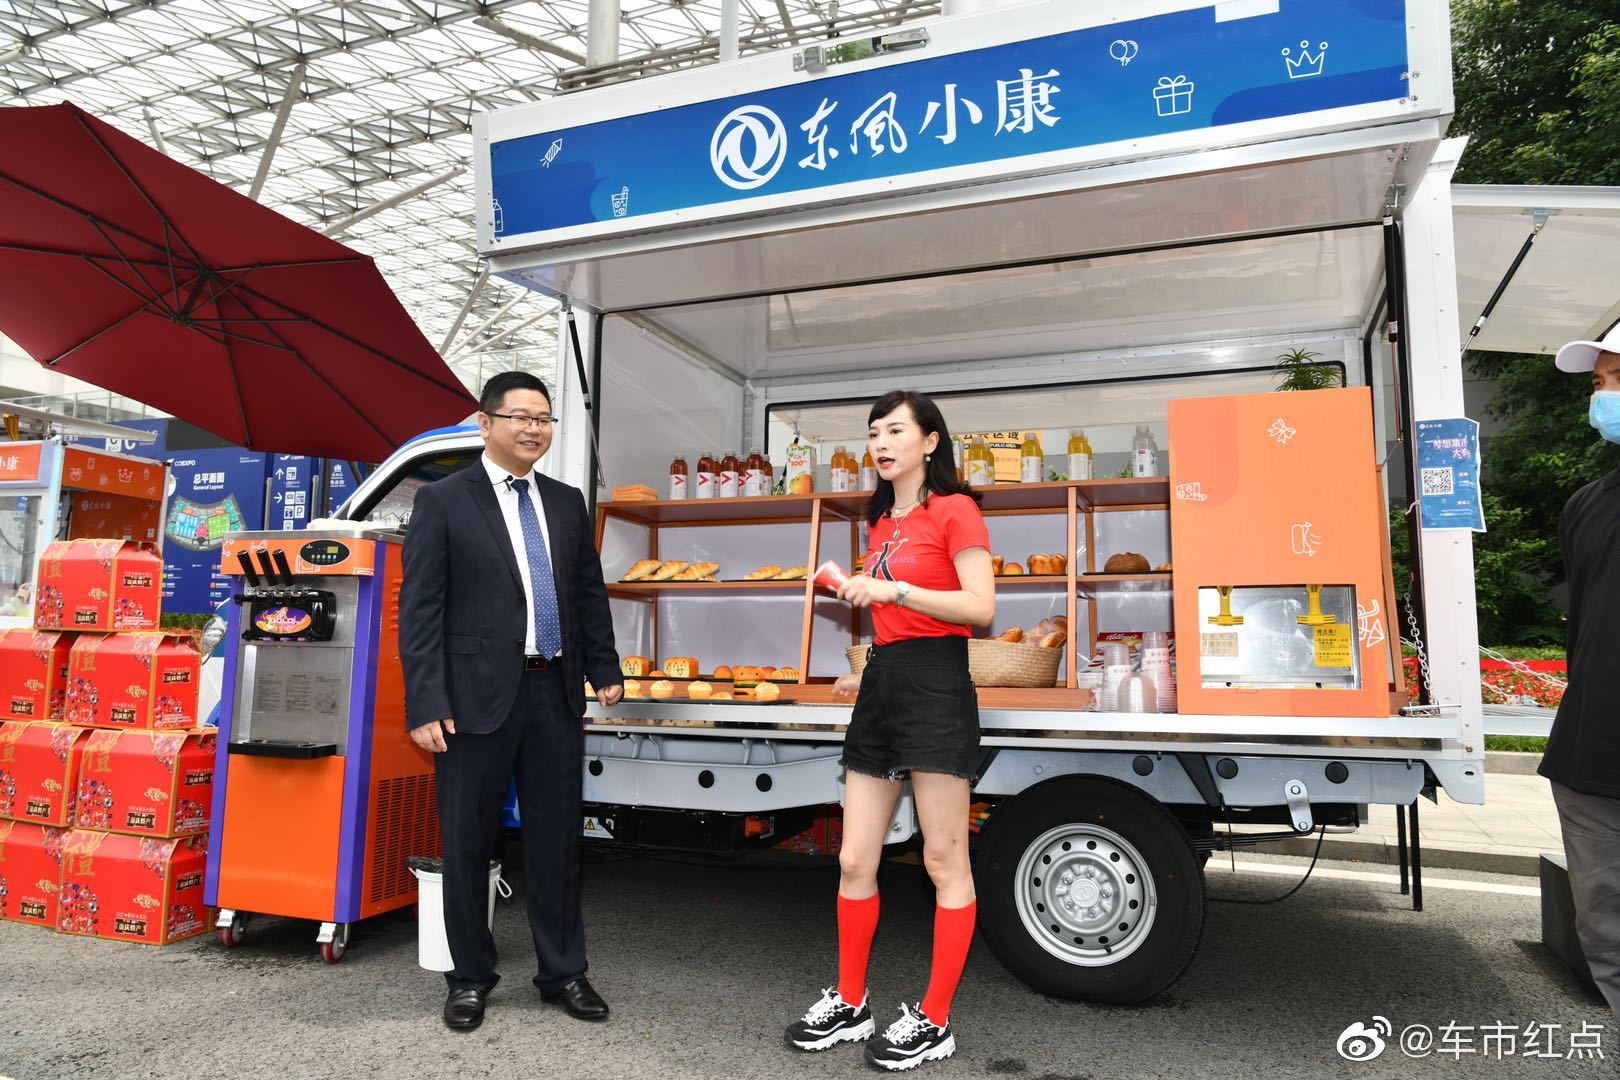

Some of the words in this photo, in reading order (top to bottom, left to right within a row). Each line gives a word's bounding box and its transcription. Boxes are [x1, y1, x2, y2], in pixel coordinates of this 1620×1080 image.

[798, 69, 1061, 170] 东风小康
[1105, 633, 1138, 641] Kellogg's
